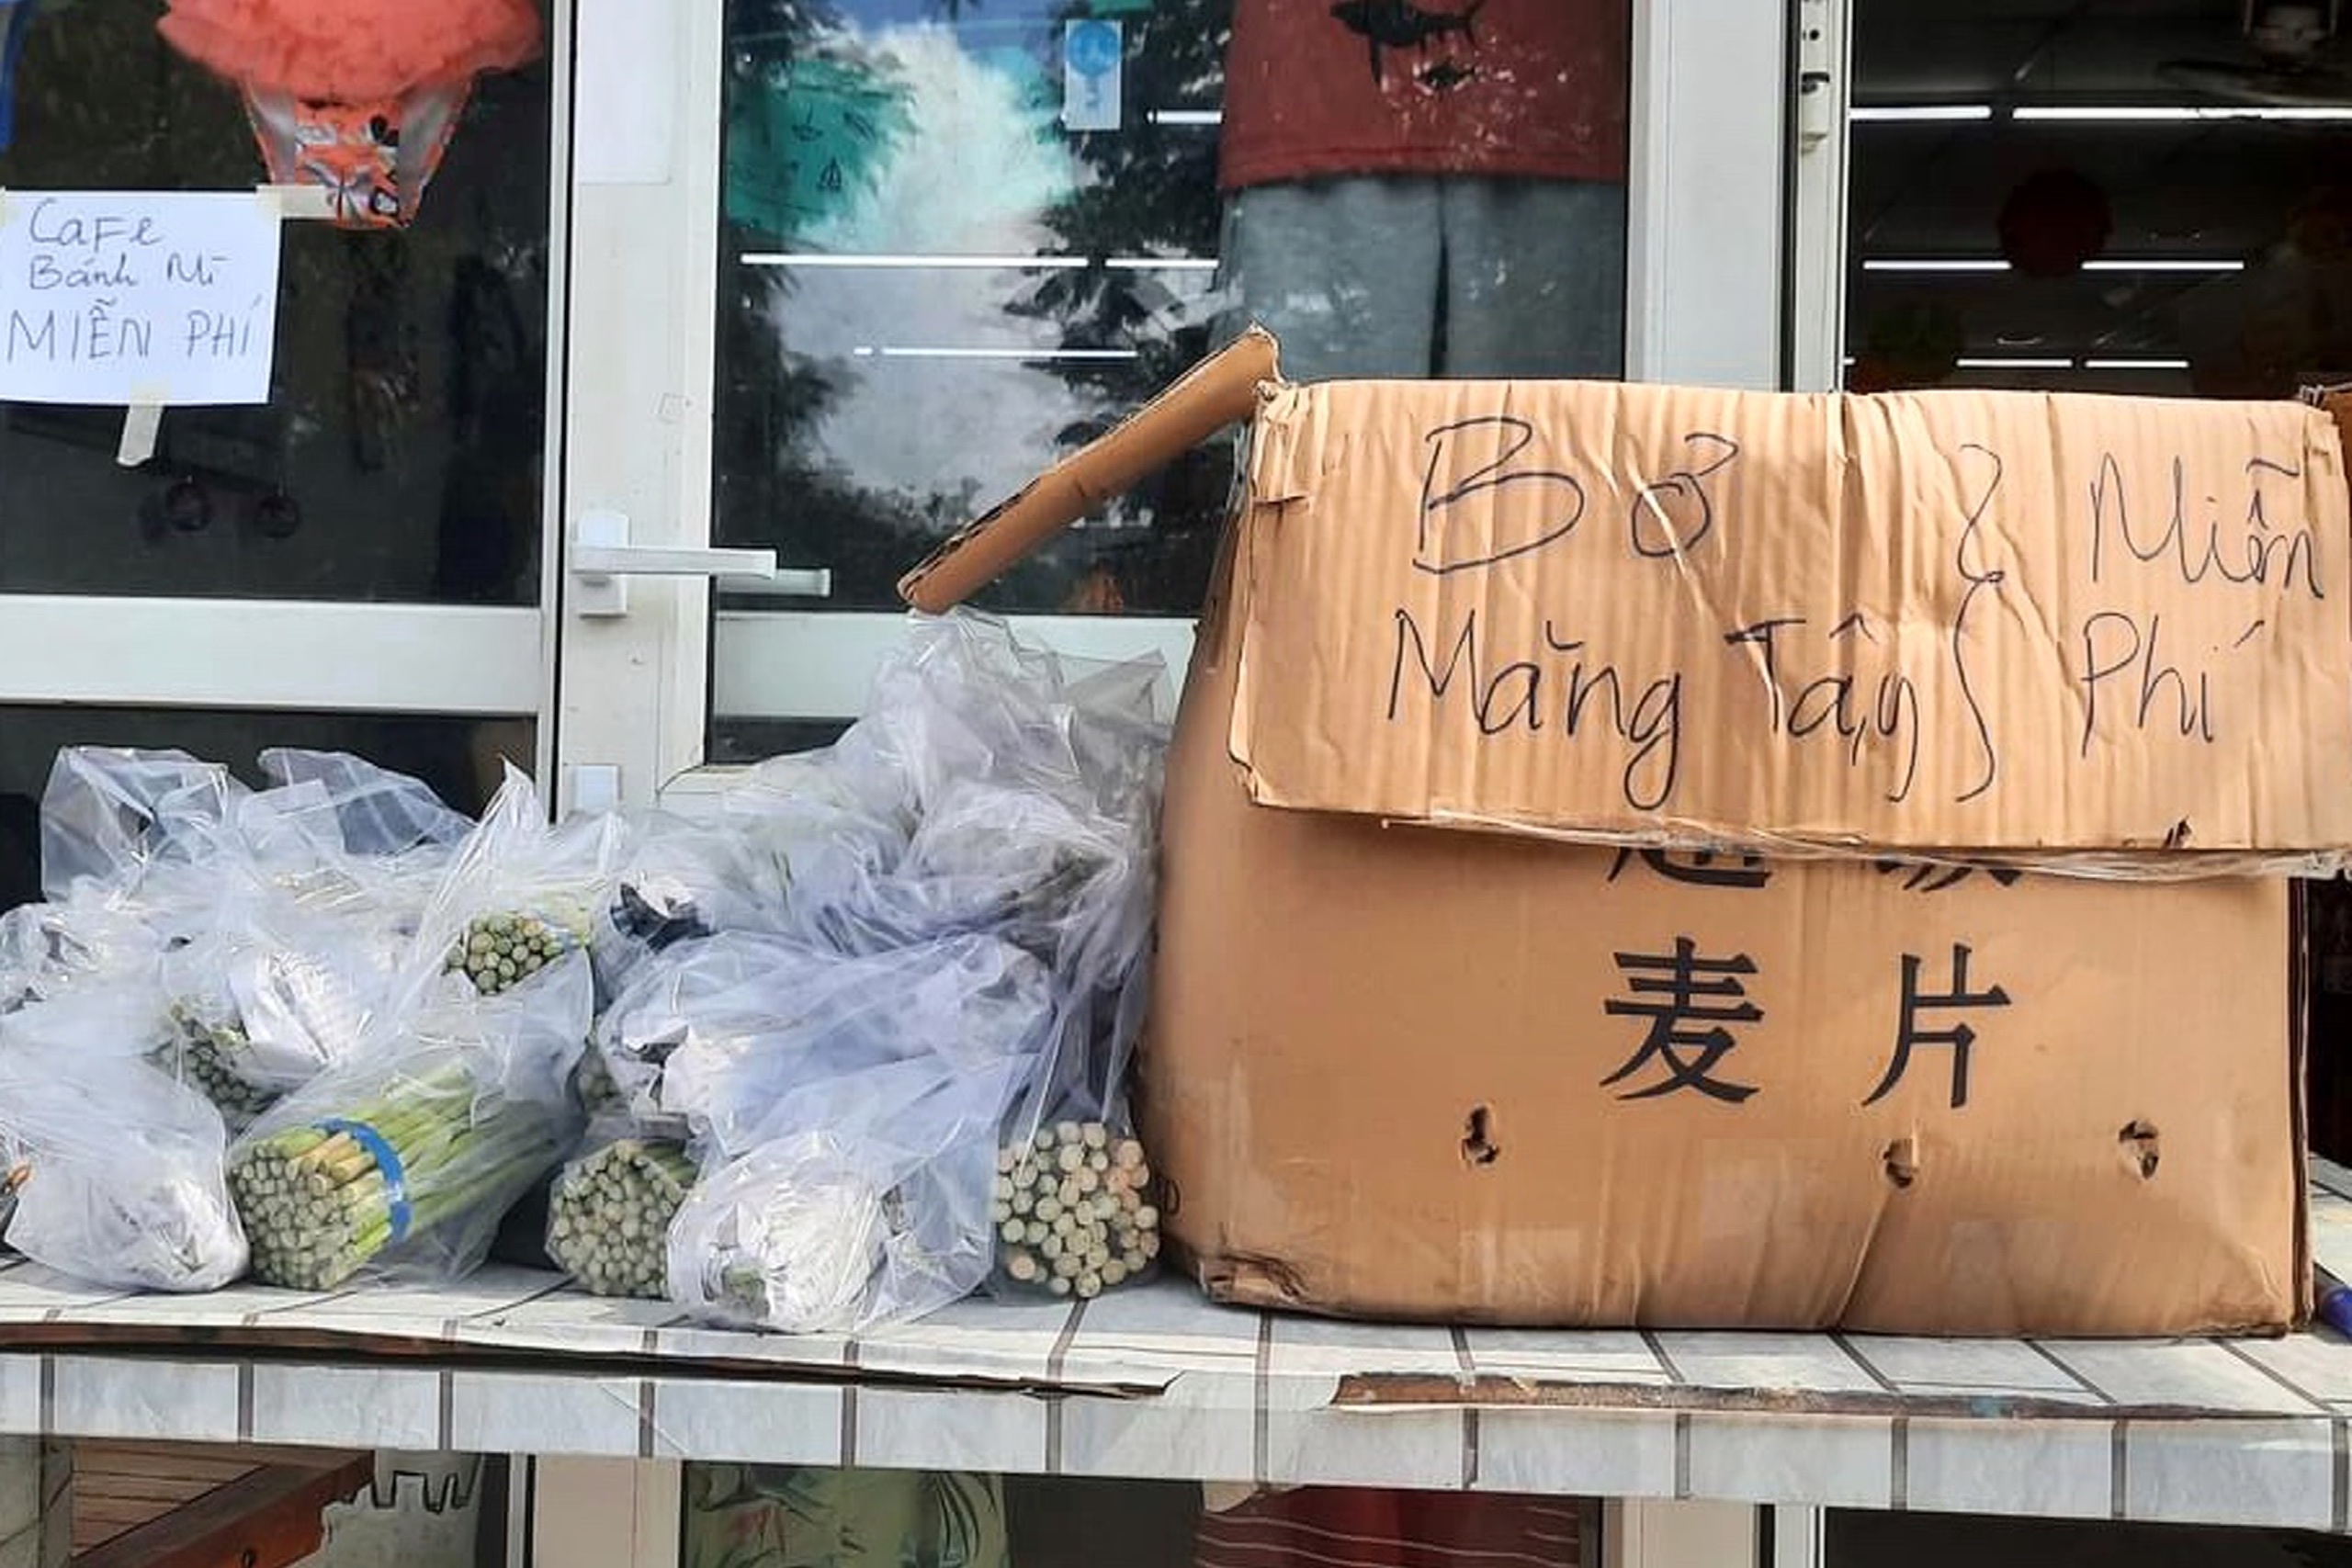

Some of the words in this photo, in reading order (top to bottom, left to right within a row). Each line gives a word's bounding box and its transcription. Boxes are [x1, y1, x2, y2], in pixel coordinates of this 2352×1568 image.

[7, 296, 152, 362] MIỄN
[186, 293, 265, 357] PHÍ
[29, 252, 138, 289] Bánh
[2090, 452, 2325, 599] Miễn
[1388, 607, 1680, 810] Măng
[2080, 612, 2266, 758] Phí
[1599, 936, 2012, 1109] 麦片
